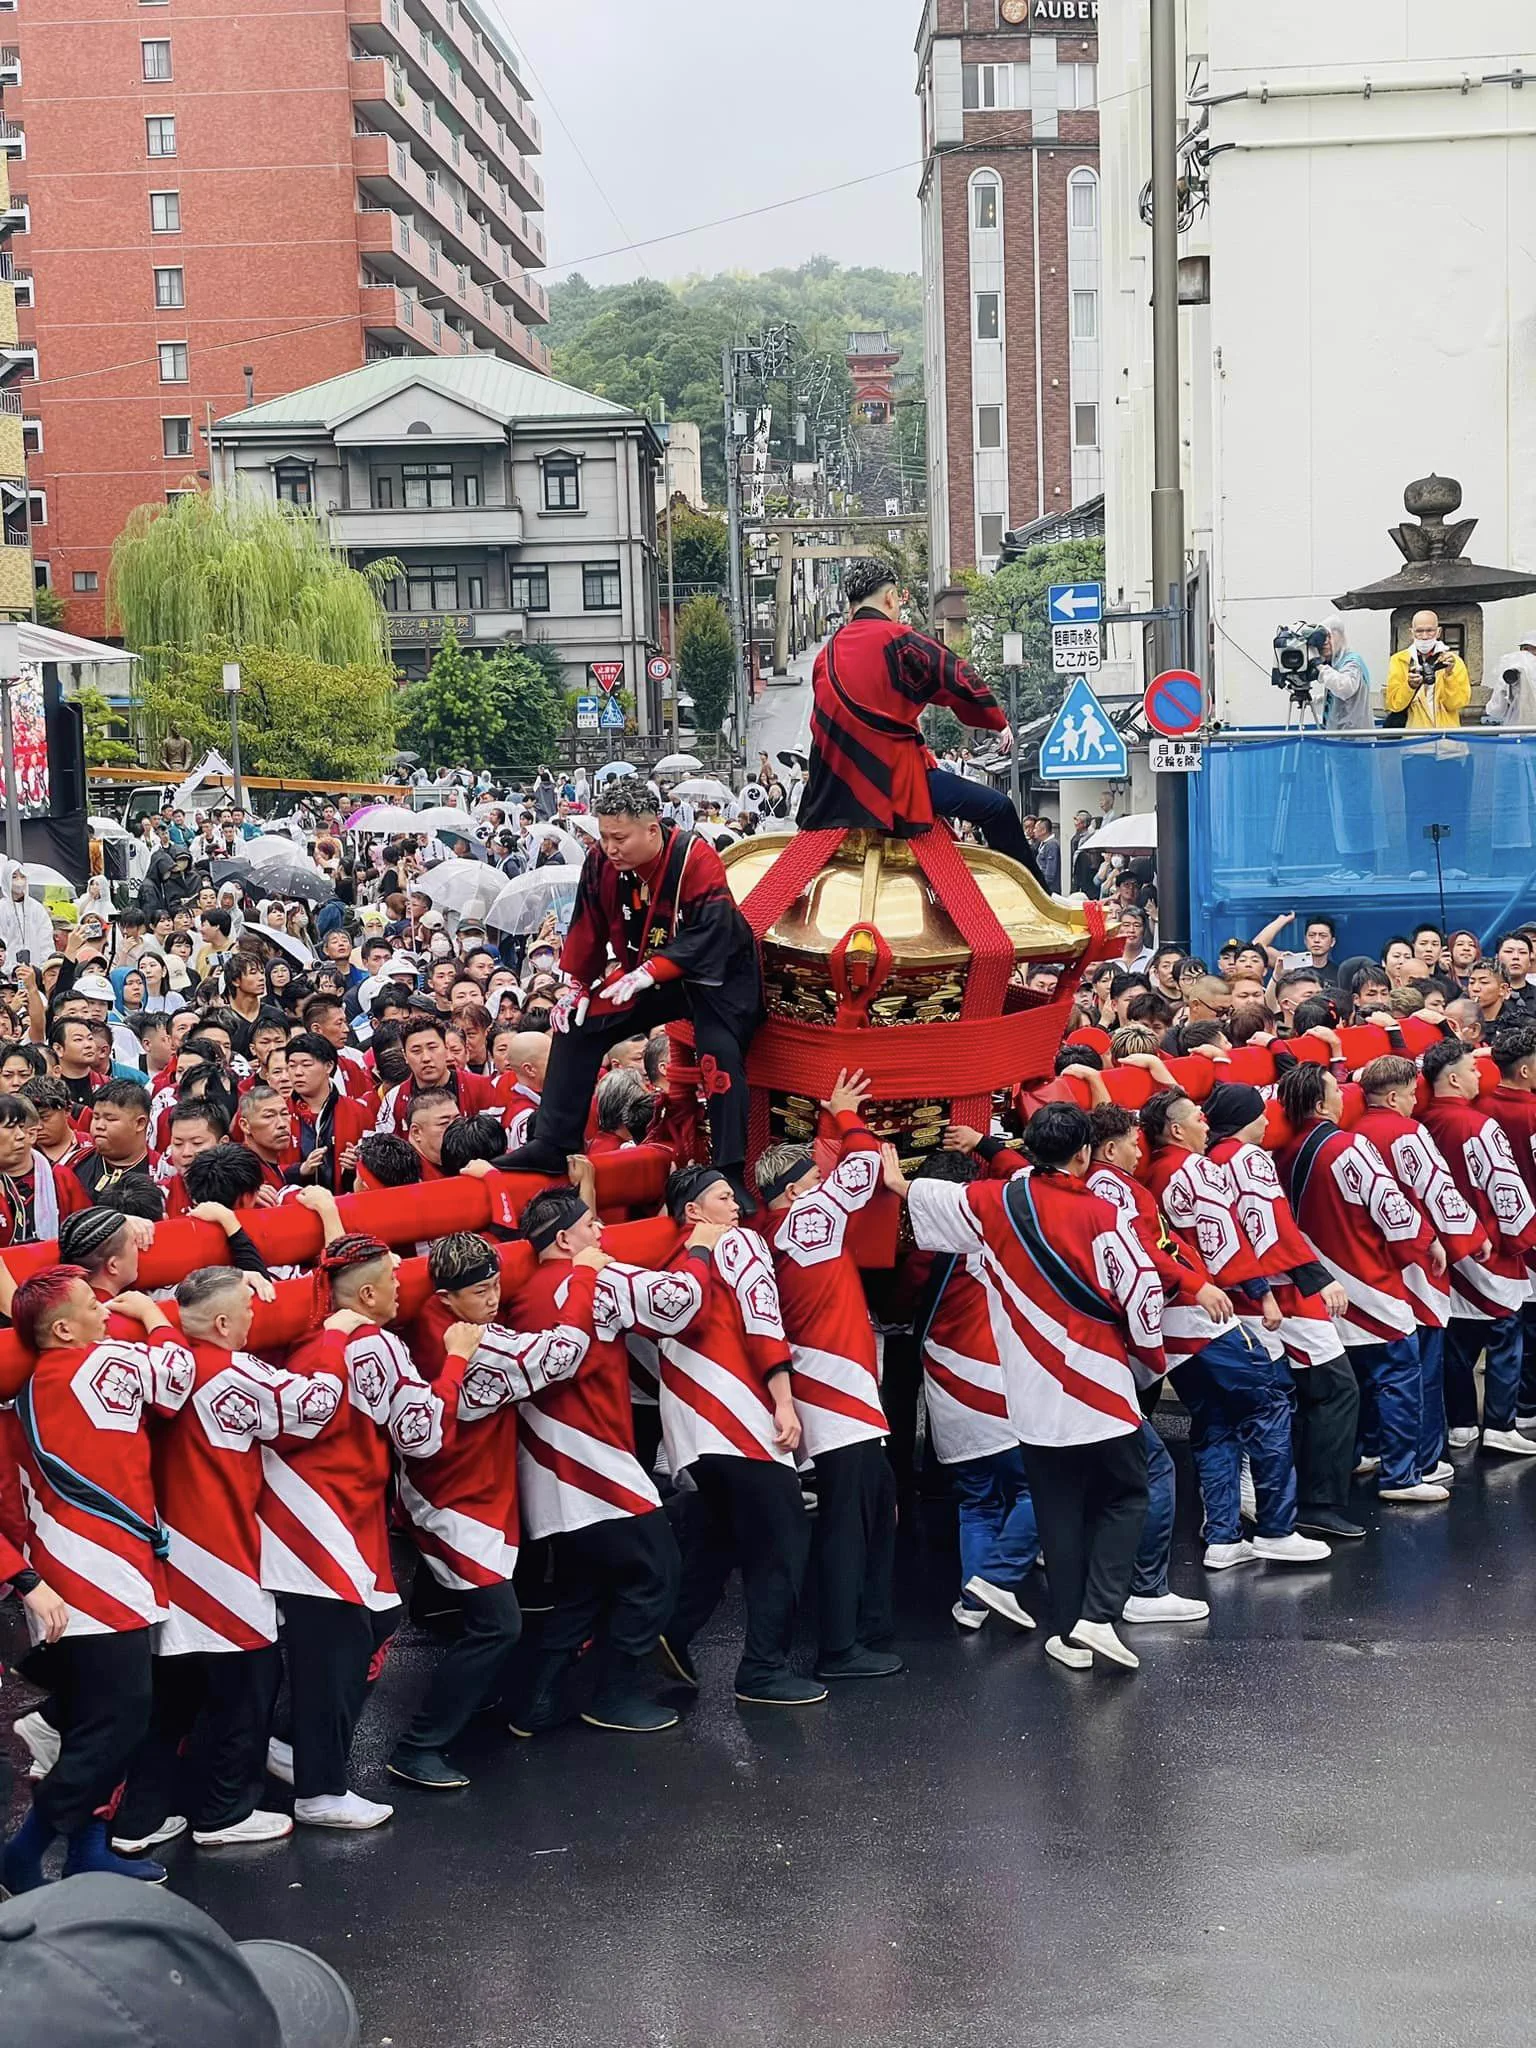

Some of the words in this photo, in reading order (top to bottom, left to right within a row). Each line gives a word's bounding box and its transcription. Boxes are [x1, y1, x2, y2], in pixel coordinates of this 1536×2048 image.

[387, 616, 469, 628] クボタ歯科院
[1054, 628, 1099, 647] 軽車両を除く
[1055, 650, 1099, 668] ここから
[653, 664, 663, 674] 15
[1158, 743, 1201, 755] 自動車
